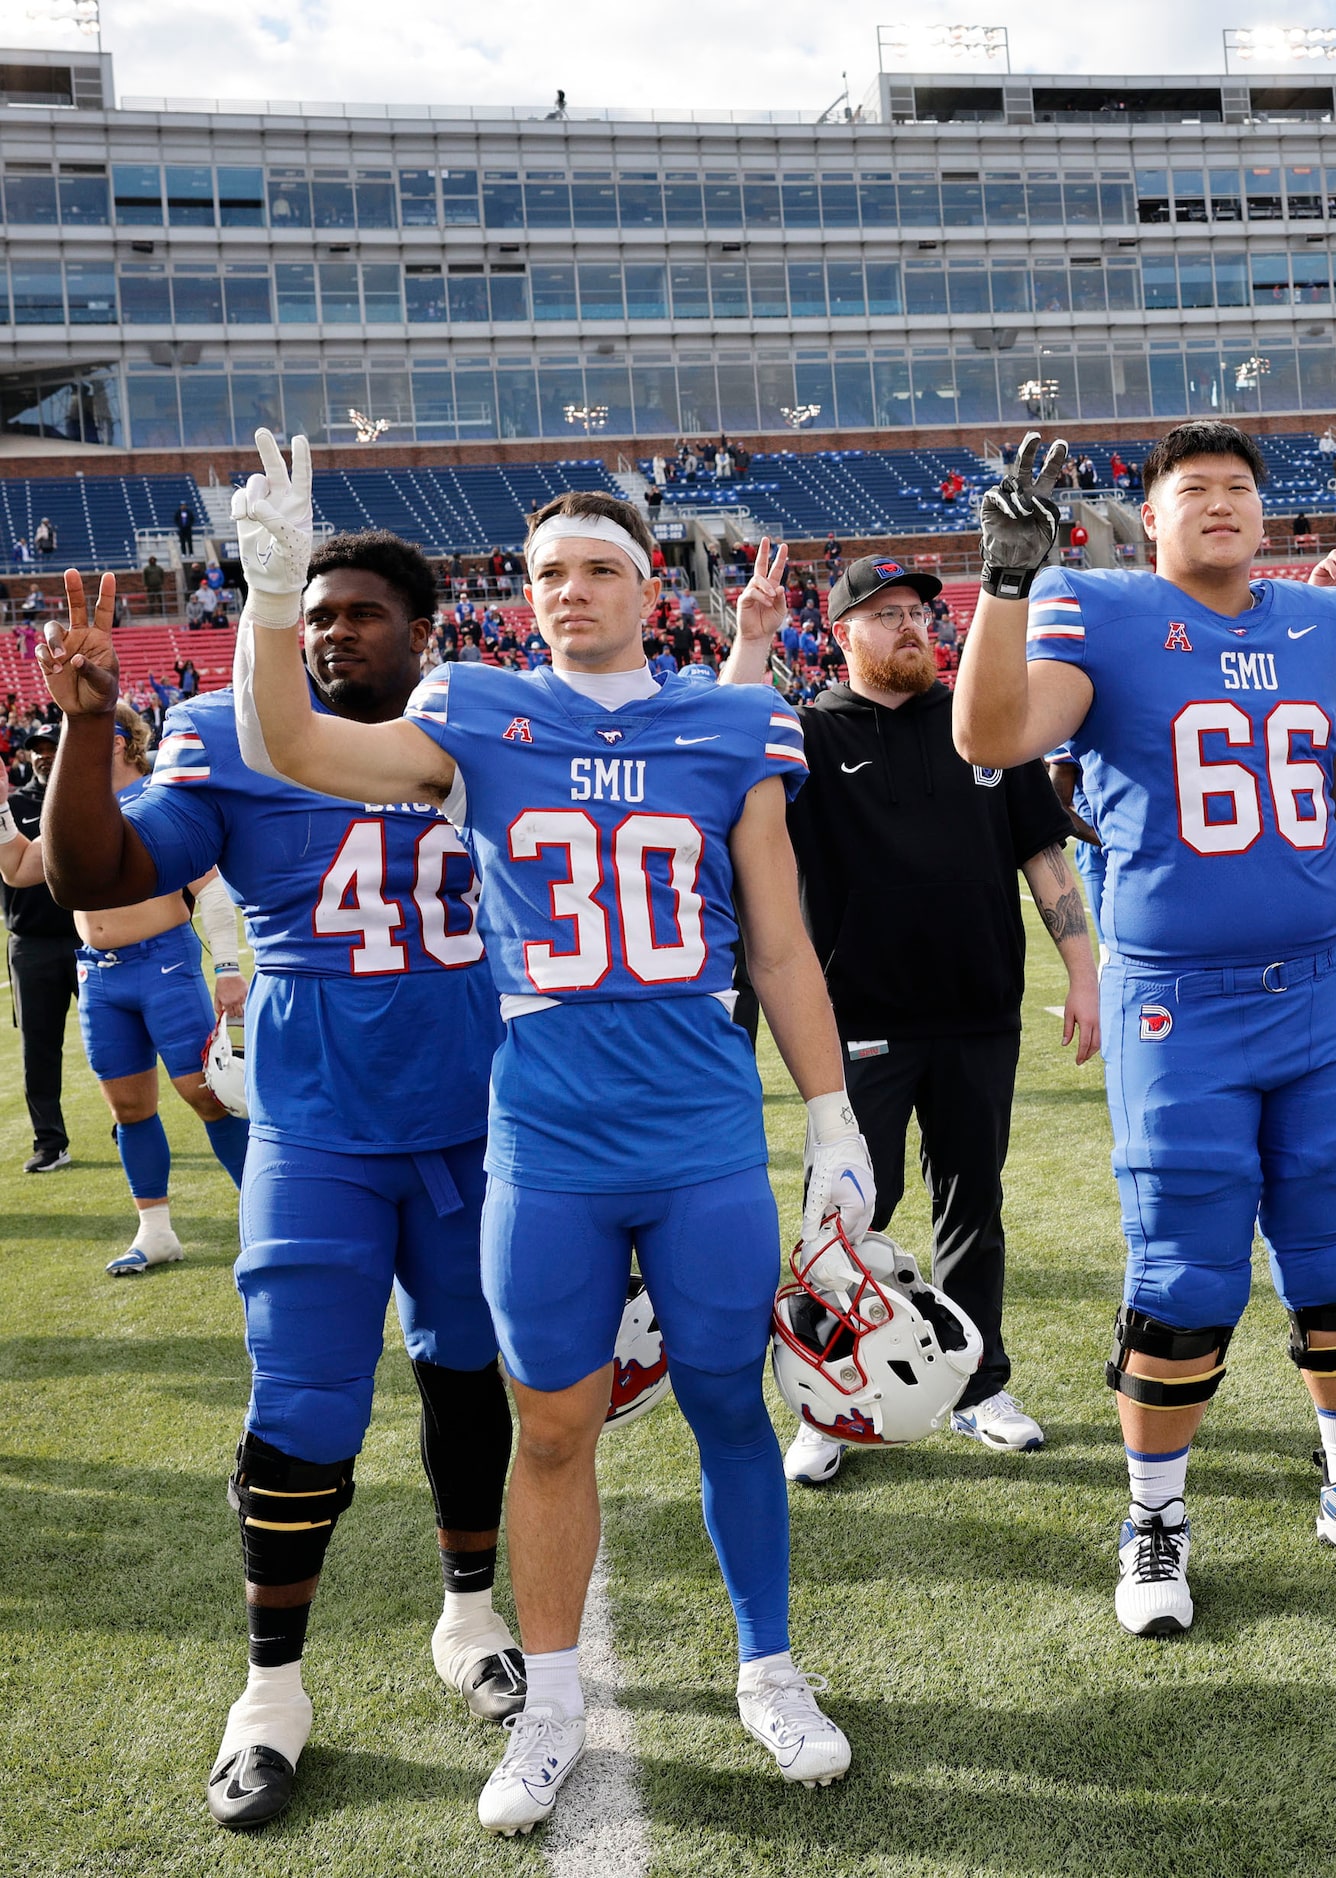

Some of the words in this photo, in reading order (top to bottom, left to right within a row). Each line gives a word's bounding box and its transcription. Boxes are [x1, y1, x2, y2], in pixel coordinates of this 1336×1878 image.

[1220, 652, 1279, 691] SMU
[570, 758, 646, 802] SMU
[1170, 699, 1333, 856] 66
[312, 818, 485, 976] 40
[508, 808, 710, 994] 30
